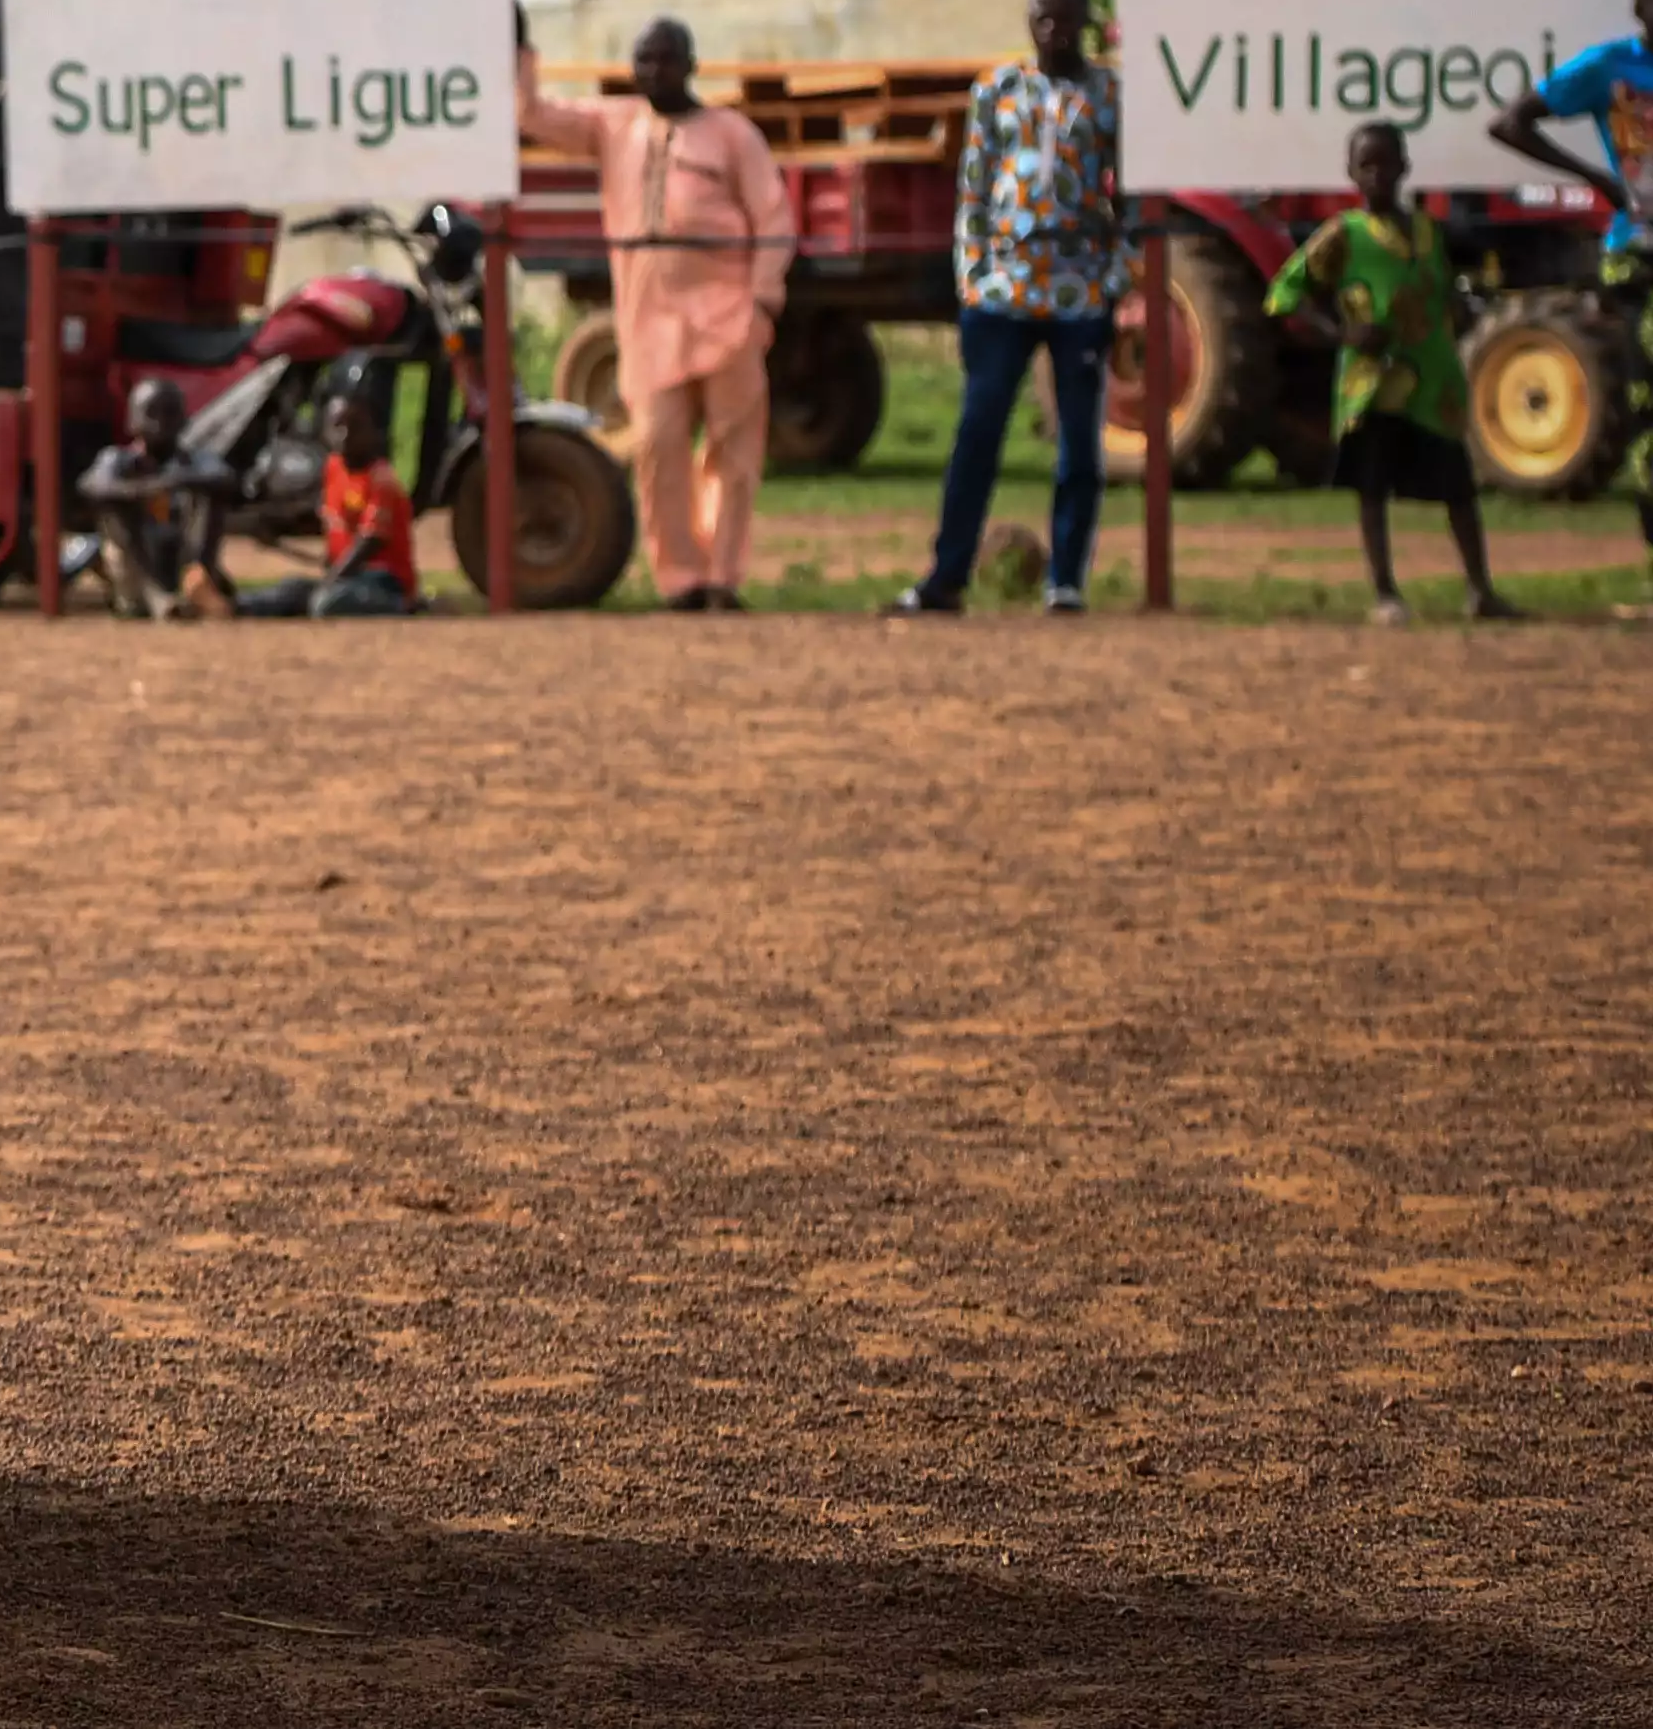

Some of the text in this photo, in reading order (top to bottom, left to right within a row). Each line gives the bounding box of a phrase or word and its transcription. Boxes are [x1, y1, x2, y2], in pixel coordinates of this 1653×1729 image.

[47, 56, 479, 149] Super Ligue
[1157, 30, 1555, 131] Villageoi
